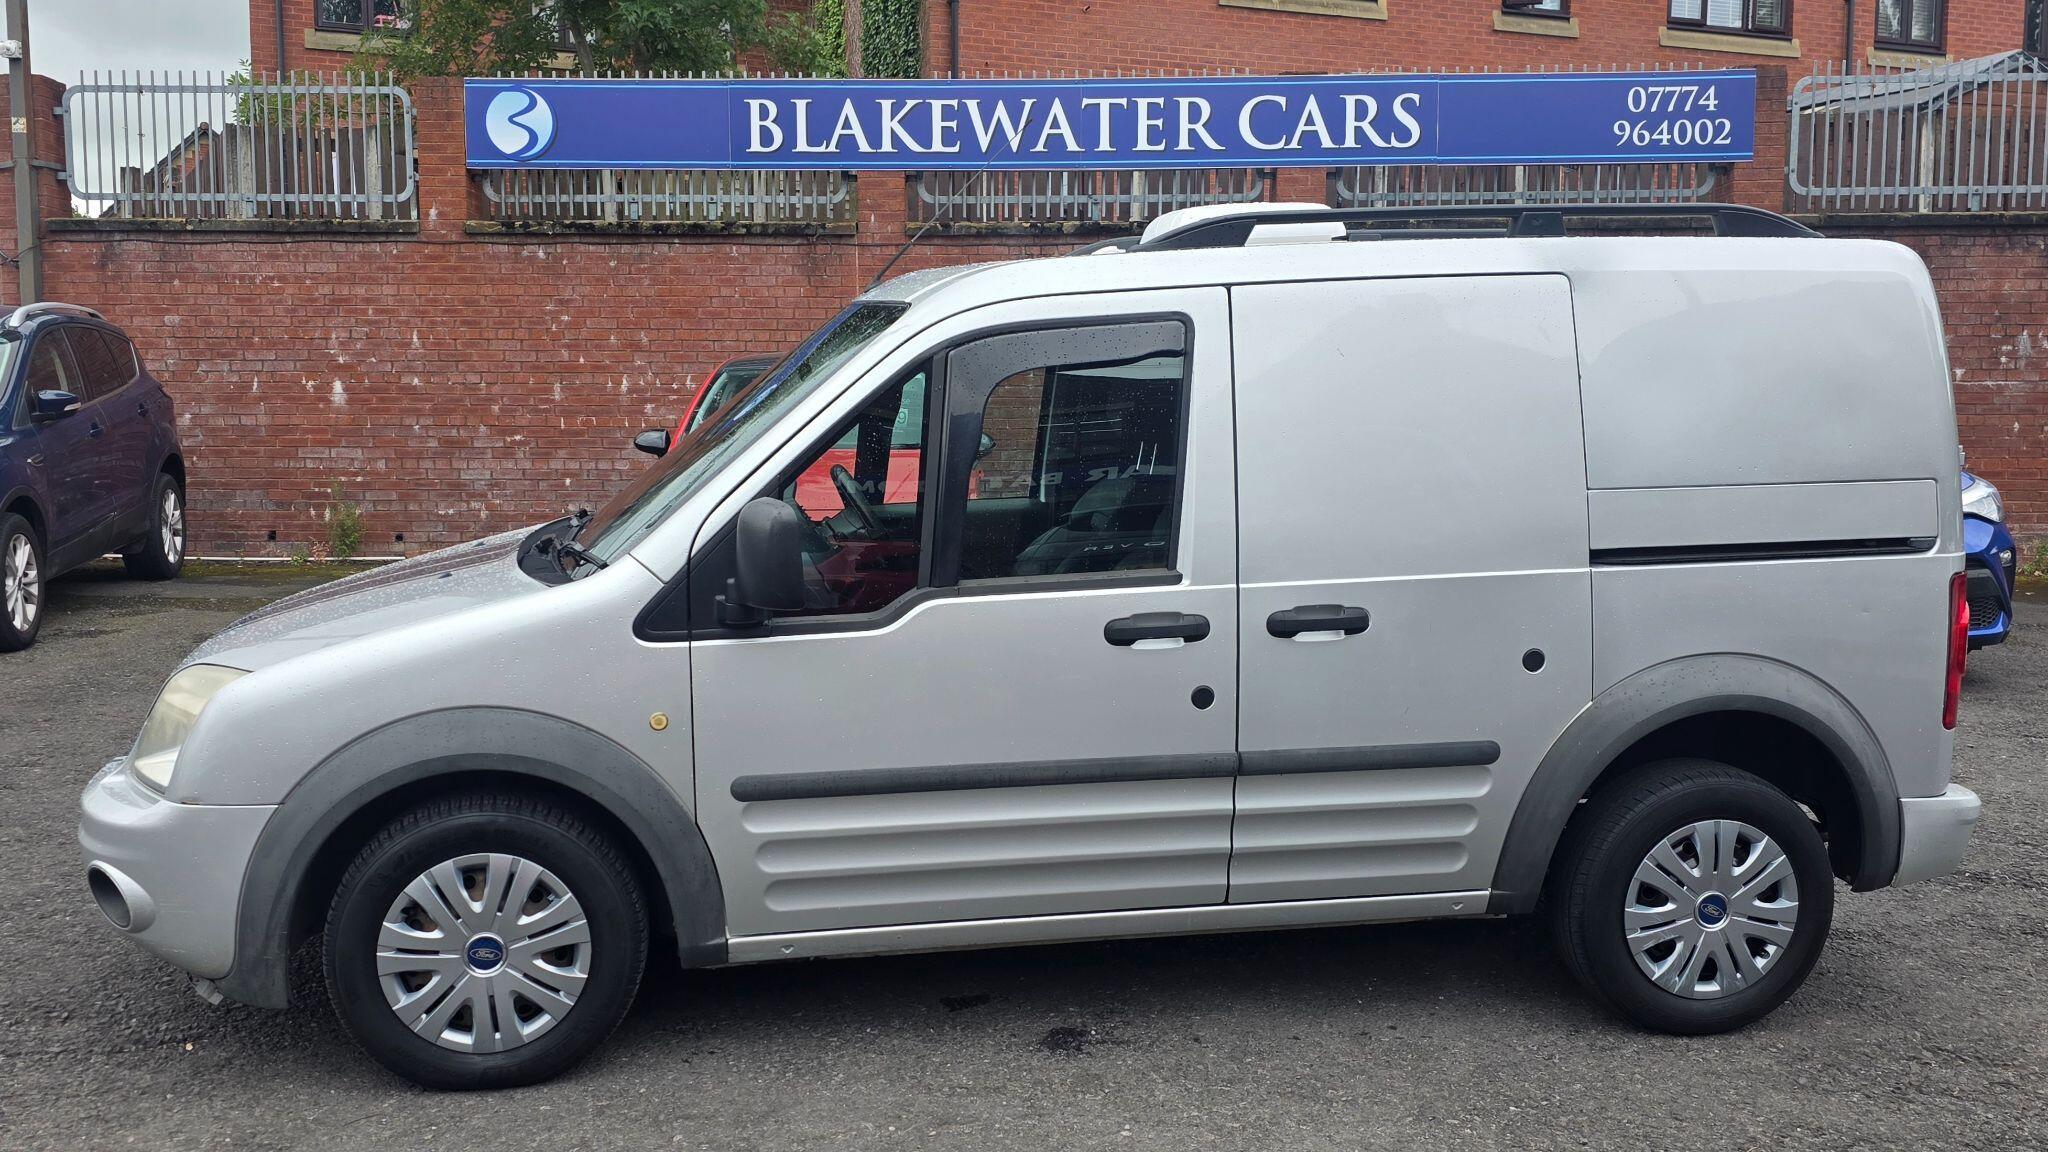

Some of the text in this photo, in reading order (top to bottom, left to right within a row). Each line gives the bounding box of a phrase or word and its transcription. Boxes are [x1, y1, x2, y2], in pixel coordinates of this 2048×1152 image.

[1627, 85, 1719, 112] 07774
[745, 92, 1421, 153] BLAKEWATER CARS
[1613, 118, 1732, 146] 964002
